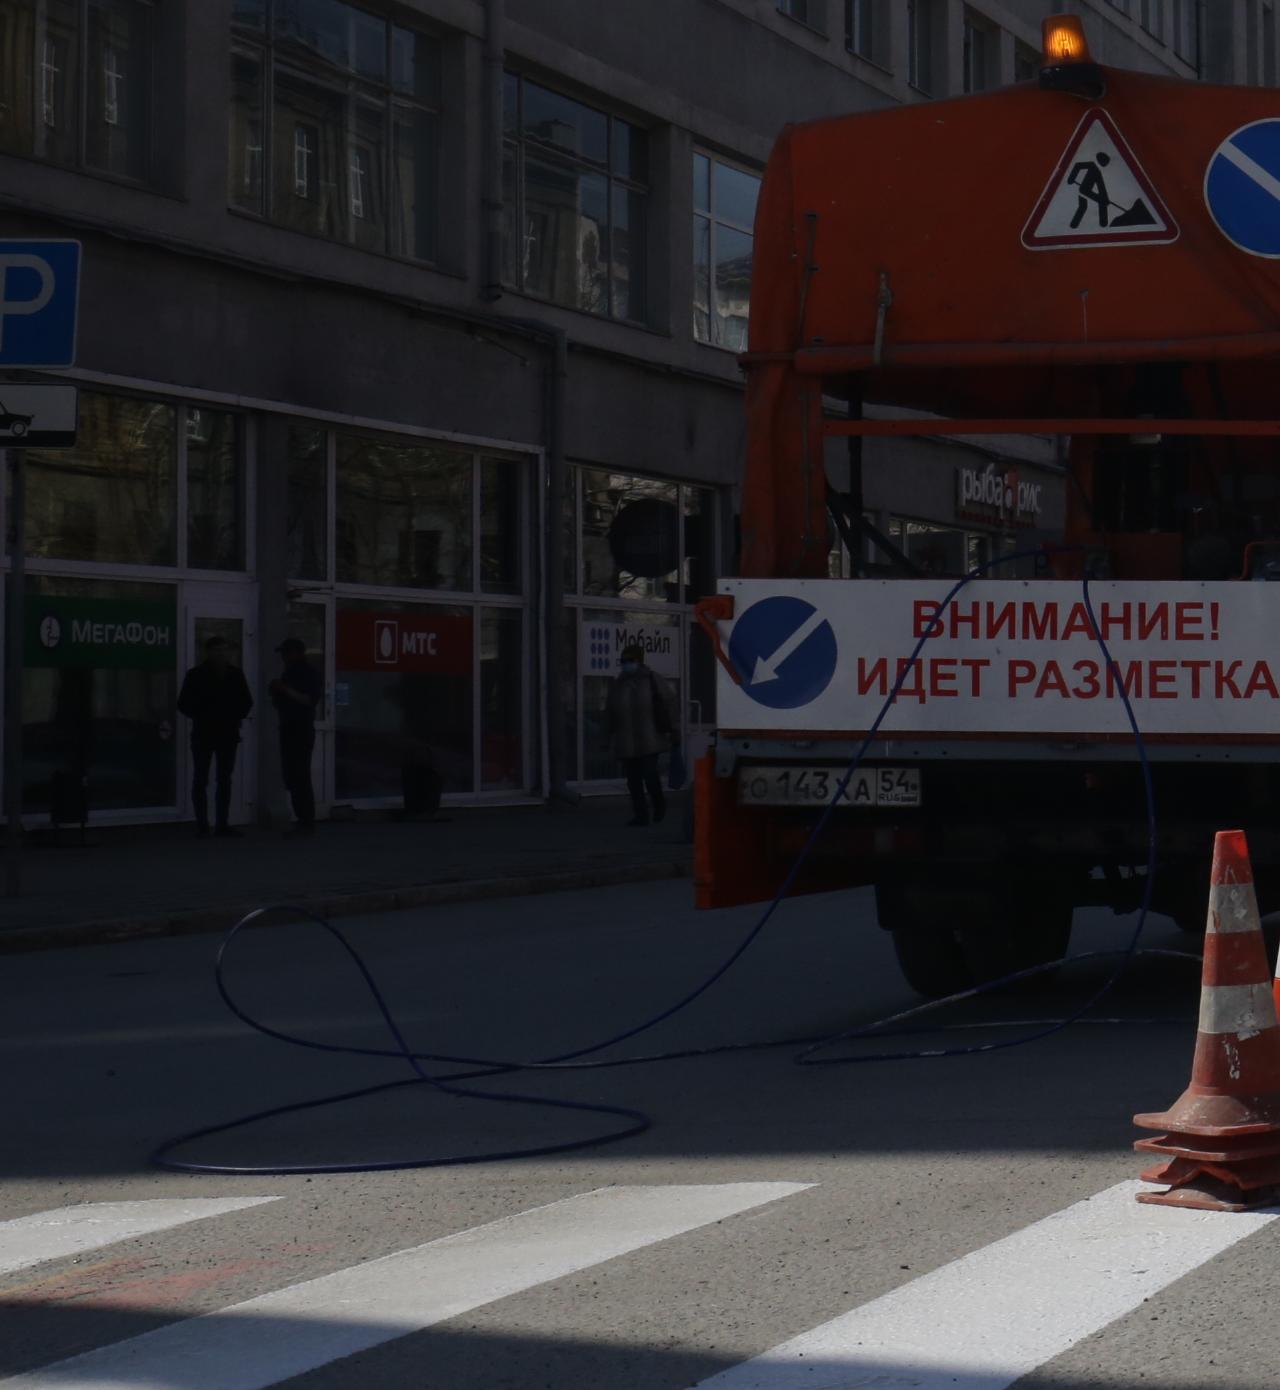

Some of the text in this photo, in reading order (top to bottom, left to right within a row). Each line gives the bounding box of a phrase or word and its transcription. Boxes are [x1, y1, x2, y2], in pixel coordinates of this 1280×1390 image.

[912, 600, 1220, 641] ВНИМАНИЕ!
[402, 631, 437, 655] МТС
[616, 628, 671, 654] Мобайл
[856, 658, 1280, 705] ИДЕТ РАЗМЕТКА
[881, 770, 909, 793] 54
